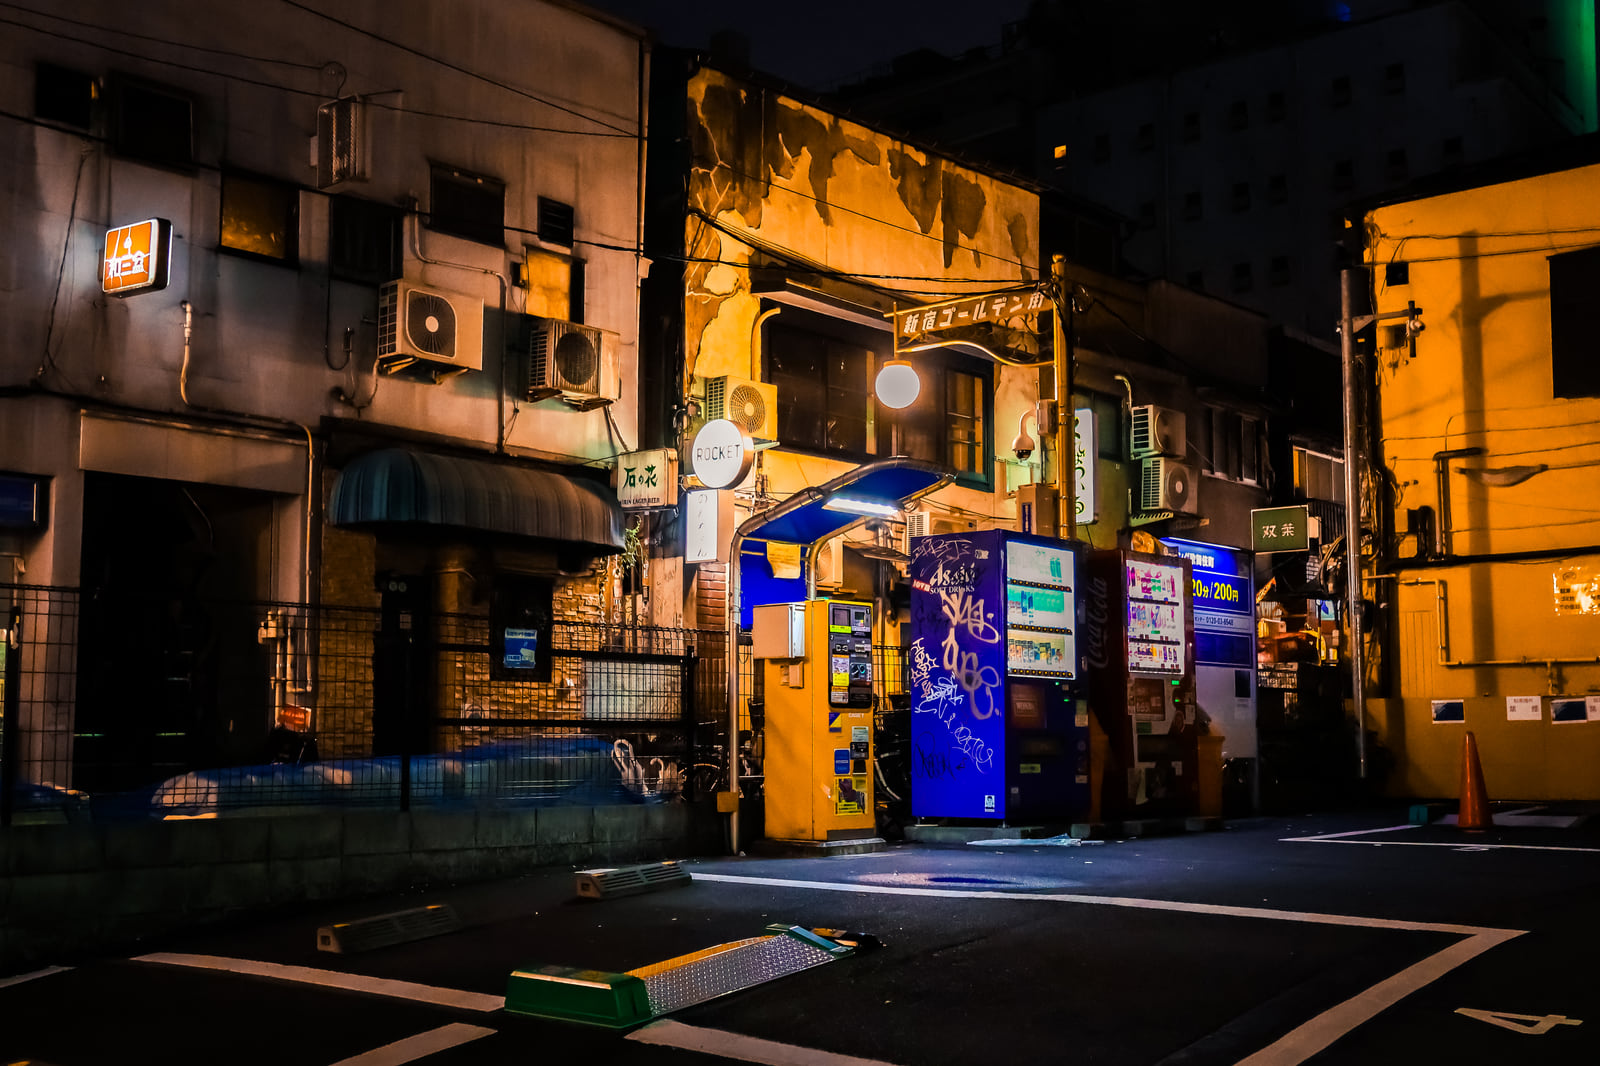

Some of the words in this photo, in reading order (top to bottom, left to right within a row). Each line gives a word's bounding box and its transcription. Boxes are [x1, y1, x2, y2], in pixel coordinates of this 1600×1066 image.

[903, 292, 1044, 334] 新宿ゴールデン街
[696, 444, 741, 462] ROCKET
[623, 464, 658, 489] 石の花
[1453, 1007, 1584, 1035] 4
